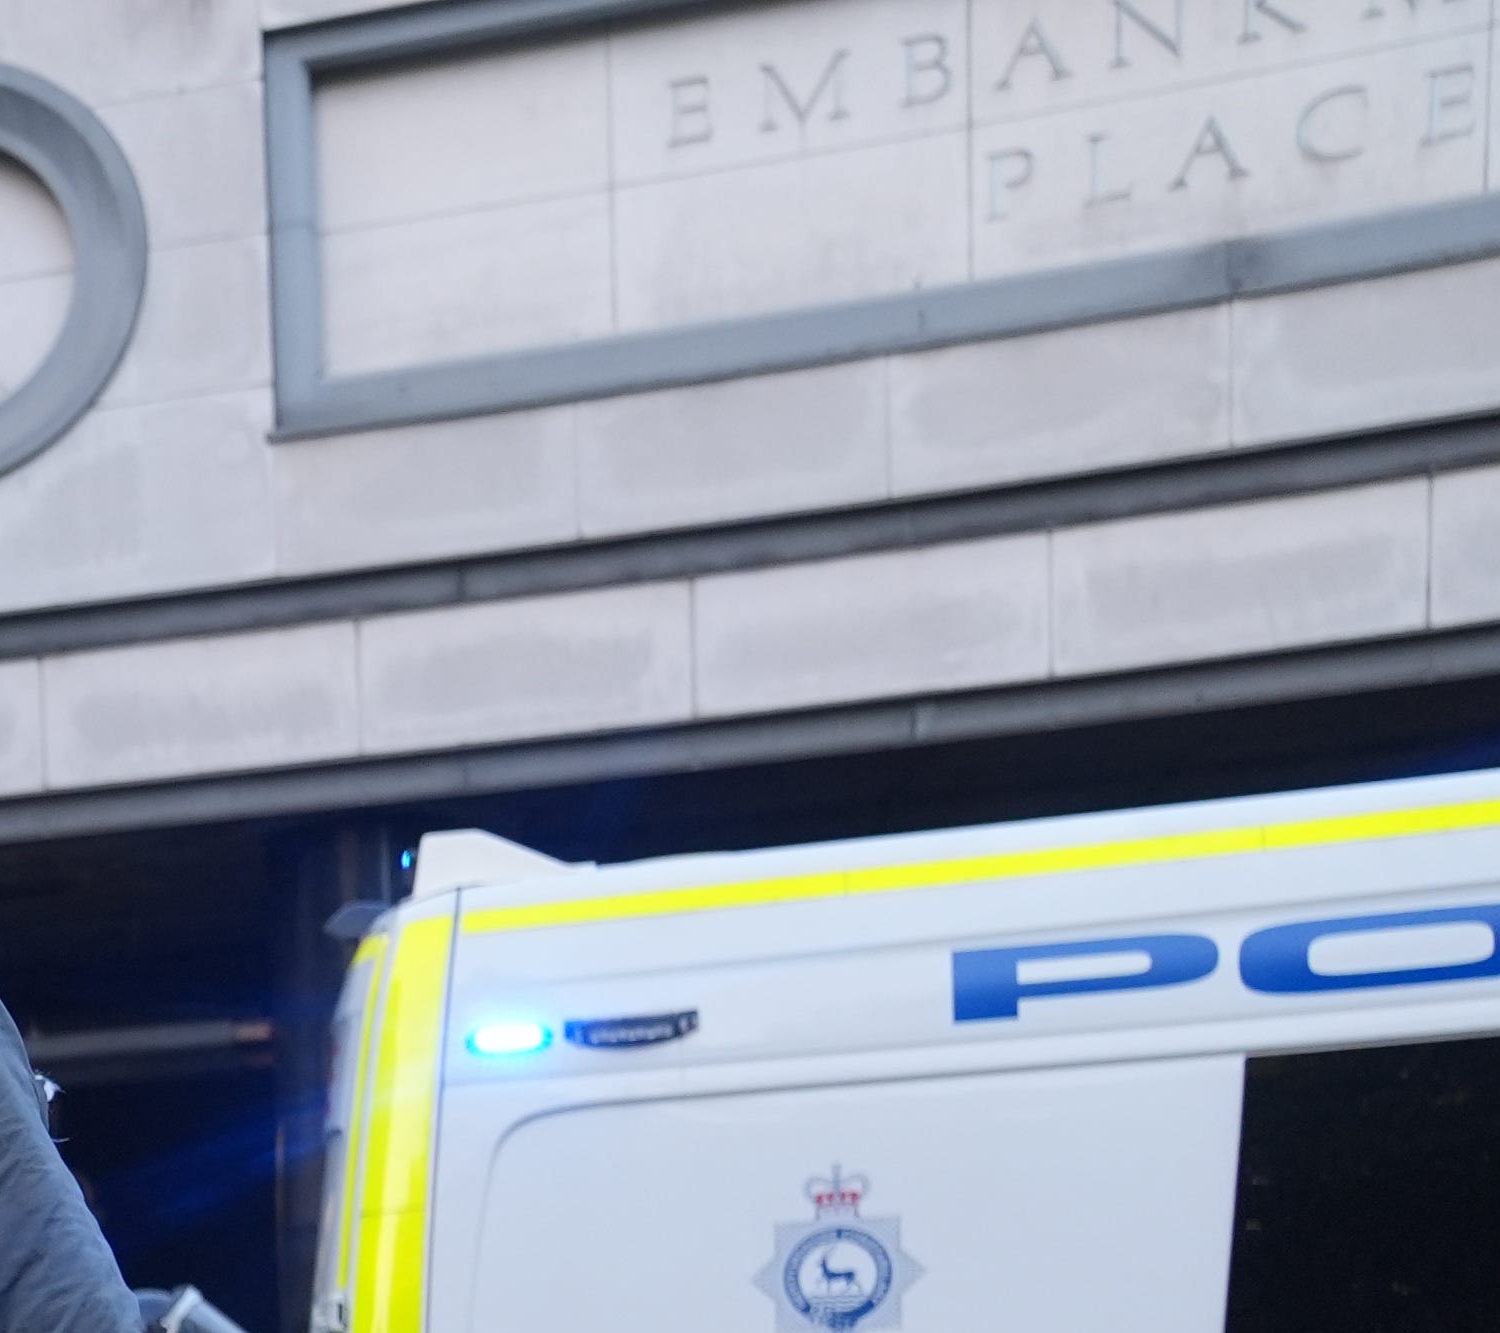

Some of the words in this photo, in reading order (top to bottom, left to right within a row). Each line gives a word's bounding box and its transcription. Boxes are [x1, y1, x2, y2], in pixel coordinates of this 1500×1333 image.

[666, 0, 1470, 148] EMBANK
[985, 63, 1478, 222] PLACE
[953, 904, 1500, 1024] PO
